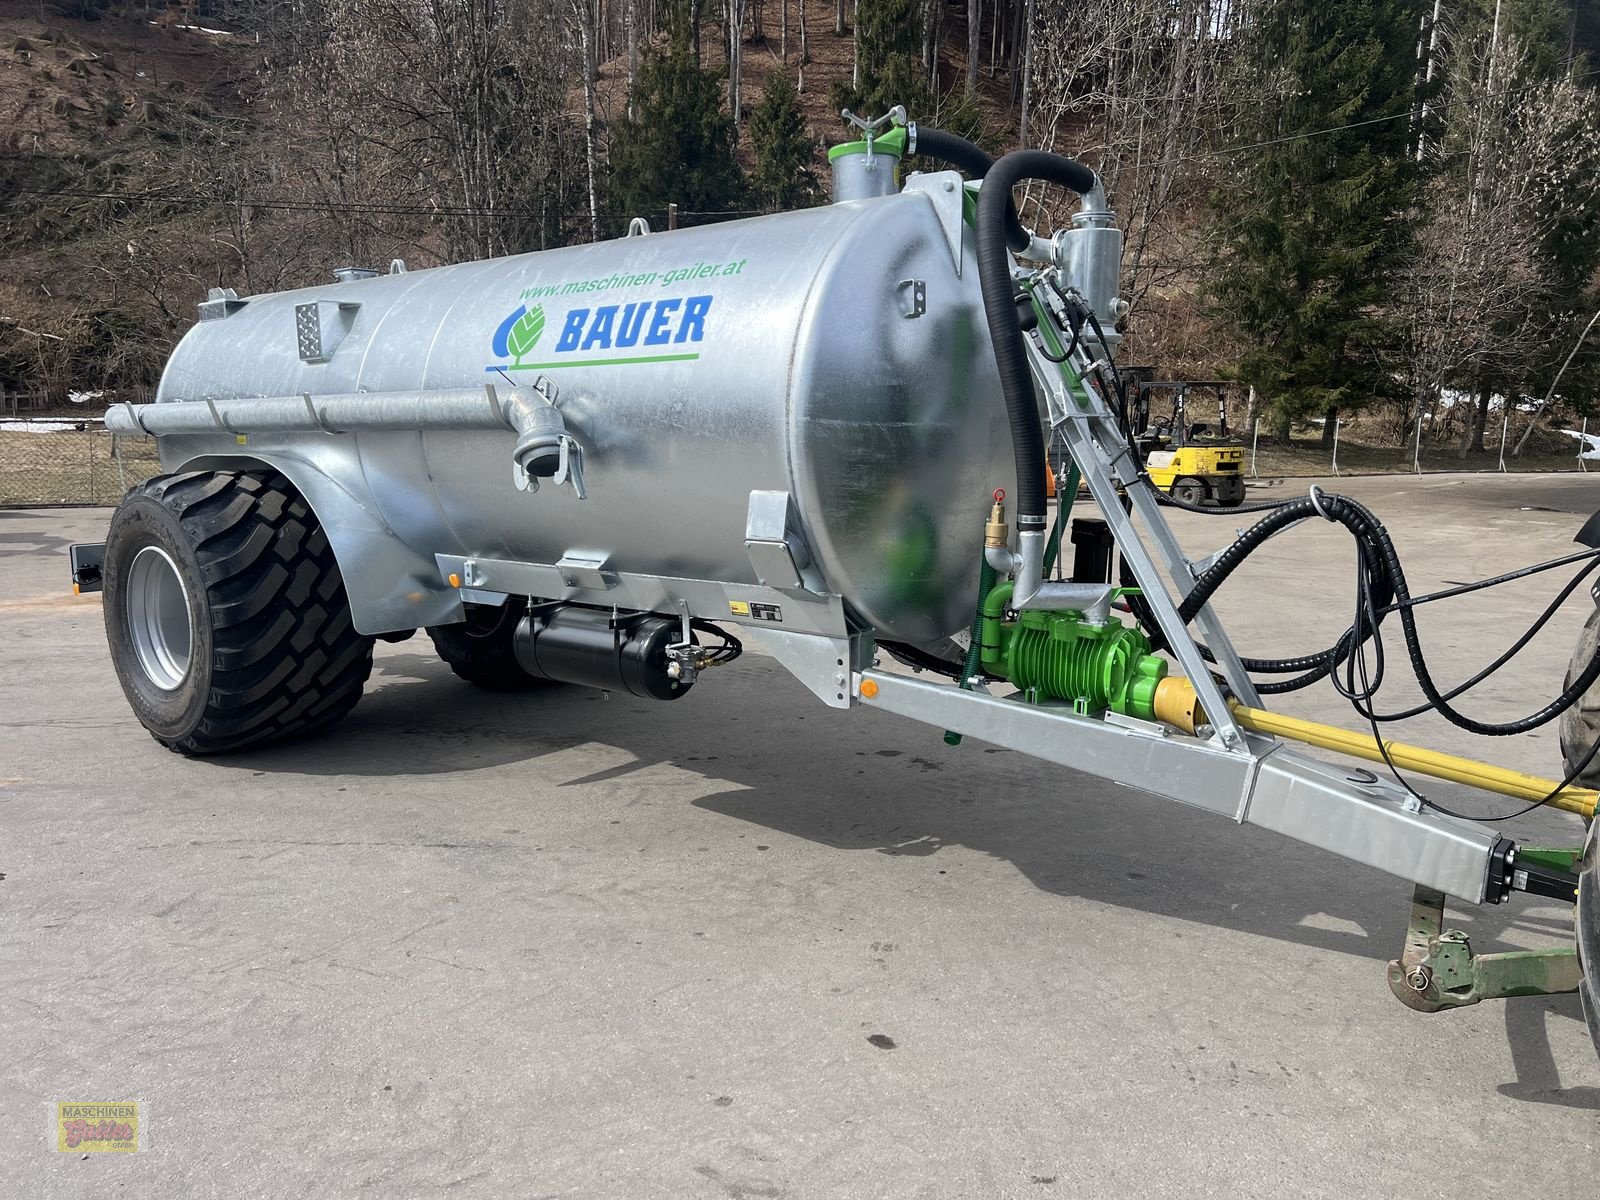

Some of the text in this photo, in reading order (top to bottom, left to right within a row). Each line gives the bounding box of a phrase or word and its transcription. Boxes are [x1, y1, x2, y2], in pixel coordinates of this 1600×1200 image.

[519, 259, 747, 300] www.maschinen-gailer.at
[555, 295, 713, 352] BAUER
[1215, 450, 1244, 459] TO
